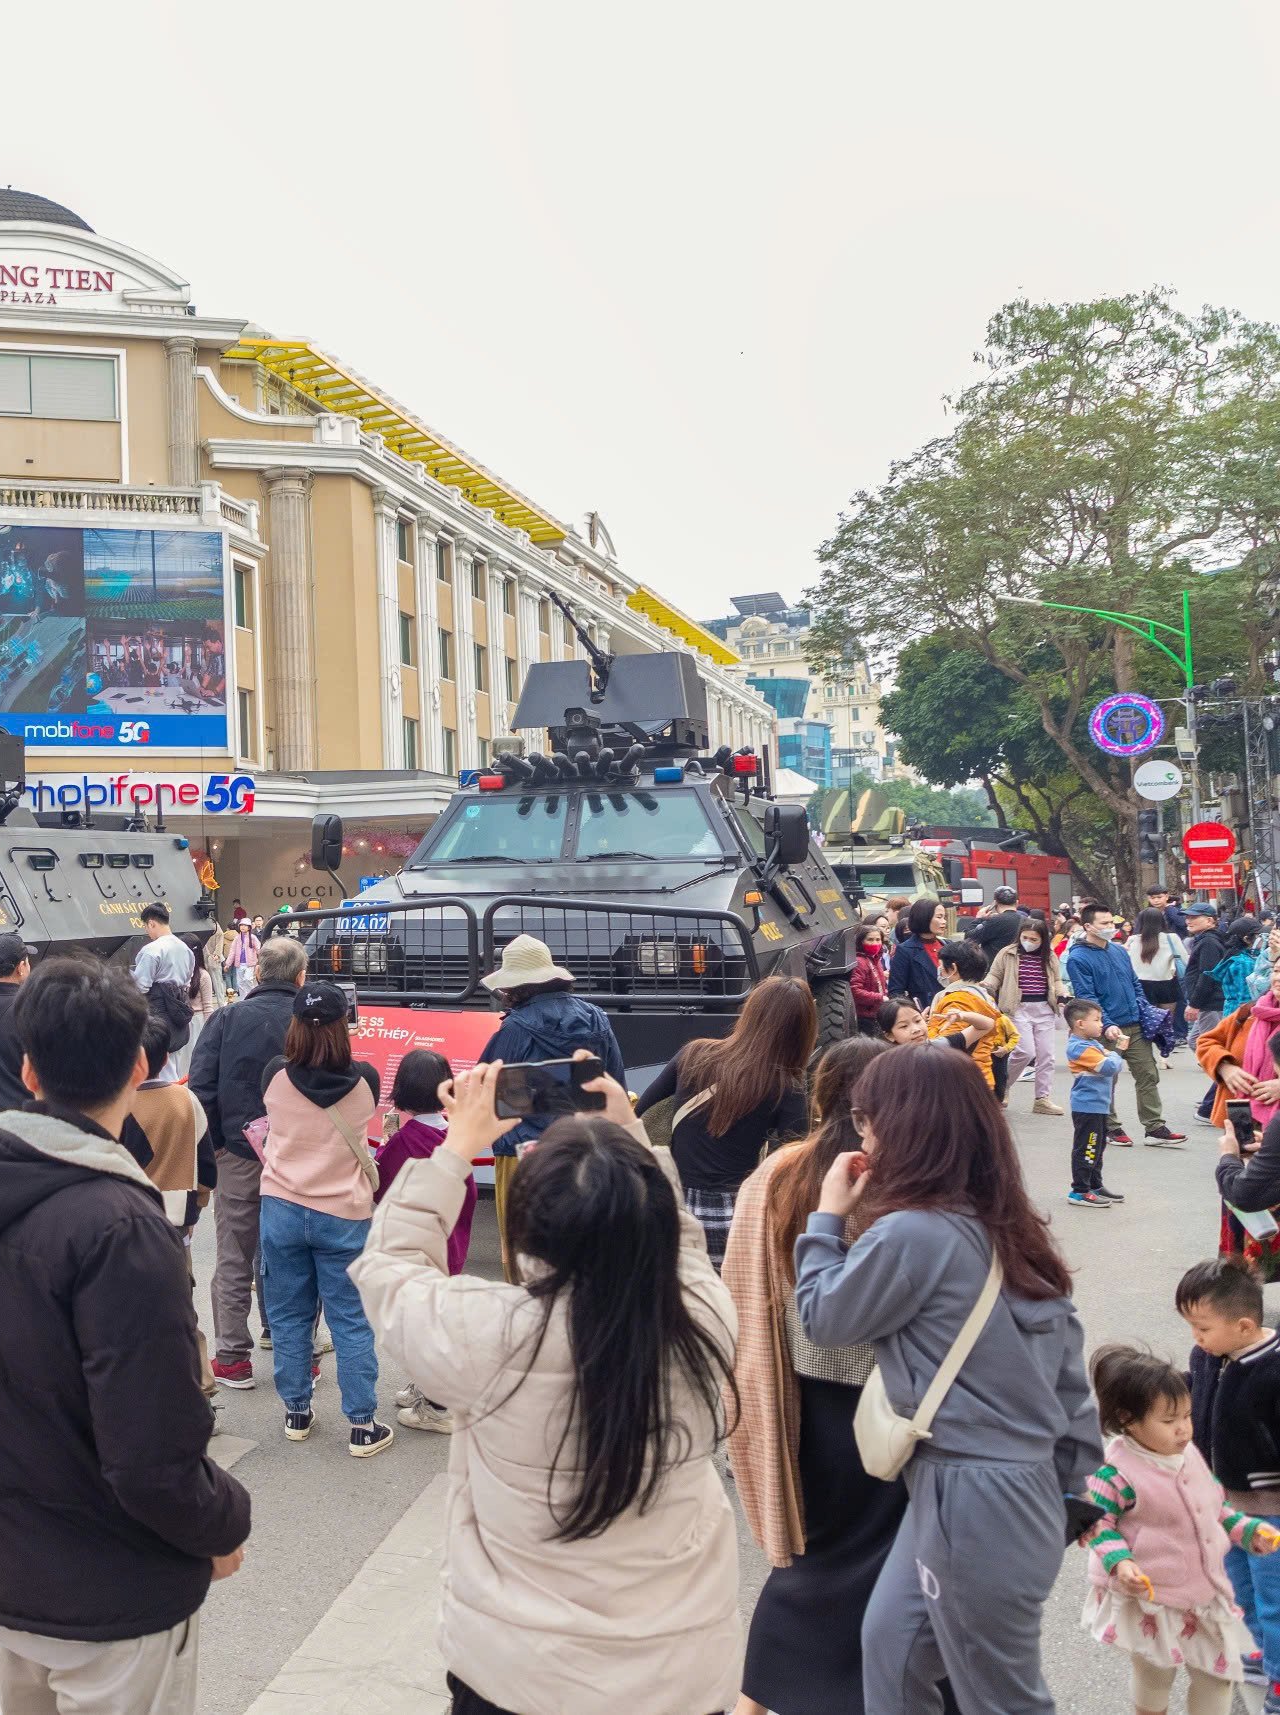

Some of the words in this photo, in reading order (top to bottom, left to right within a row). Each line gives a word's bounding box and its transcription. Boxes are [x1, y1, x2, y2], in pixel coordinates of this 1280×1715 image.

[46, 267, 115, 292] TIEN
[0, 290, 58, 305] PLAZA
[24, 720, 115, 739] mobifone
[117, 720, 151, 744] 5G
[24, 774, 200, 807] mobifone
[203, 774, 256, 814] 5G
[272, 885, 334, 898] GUCCI
[368, 1017, 385, 1027] S5
[377, 1027, 409, 1040] THÉP
